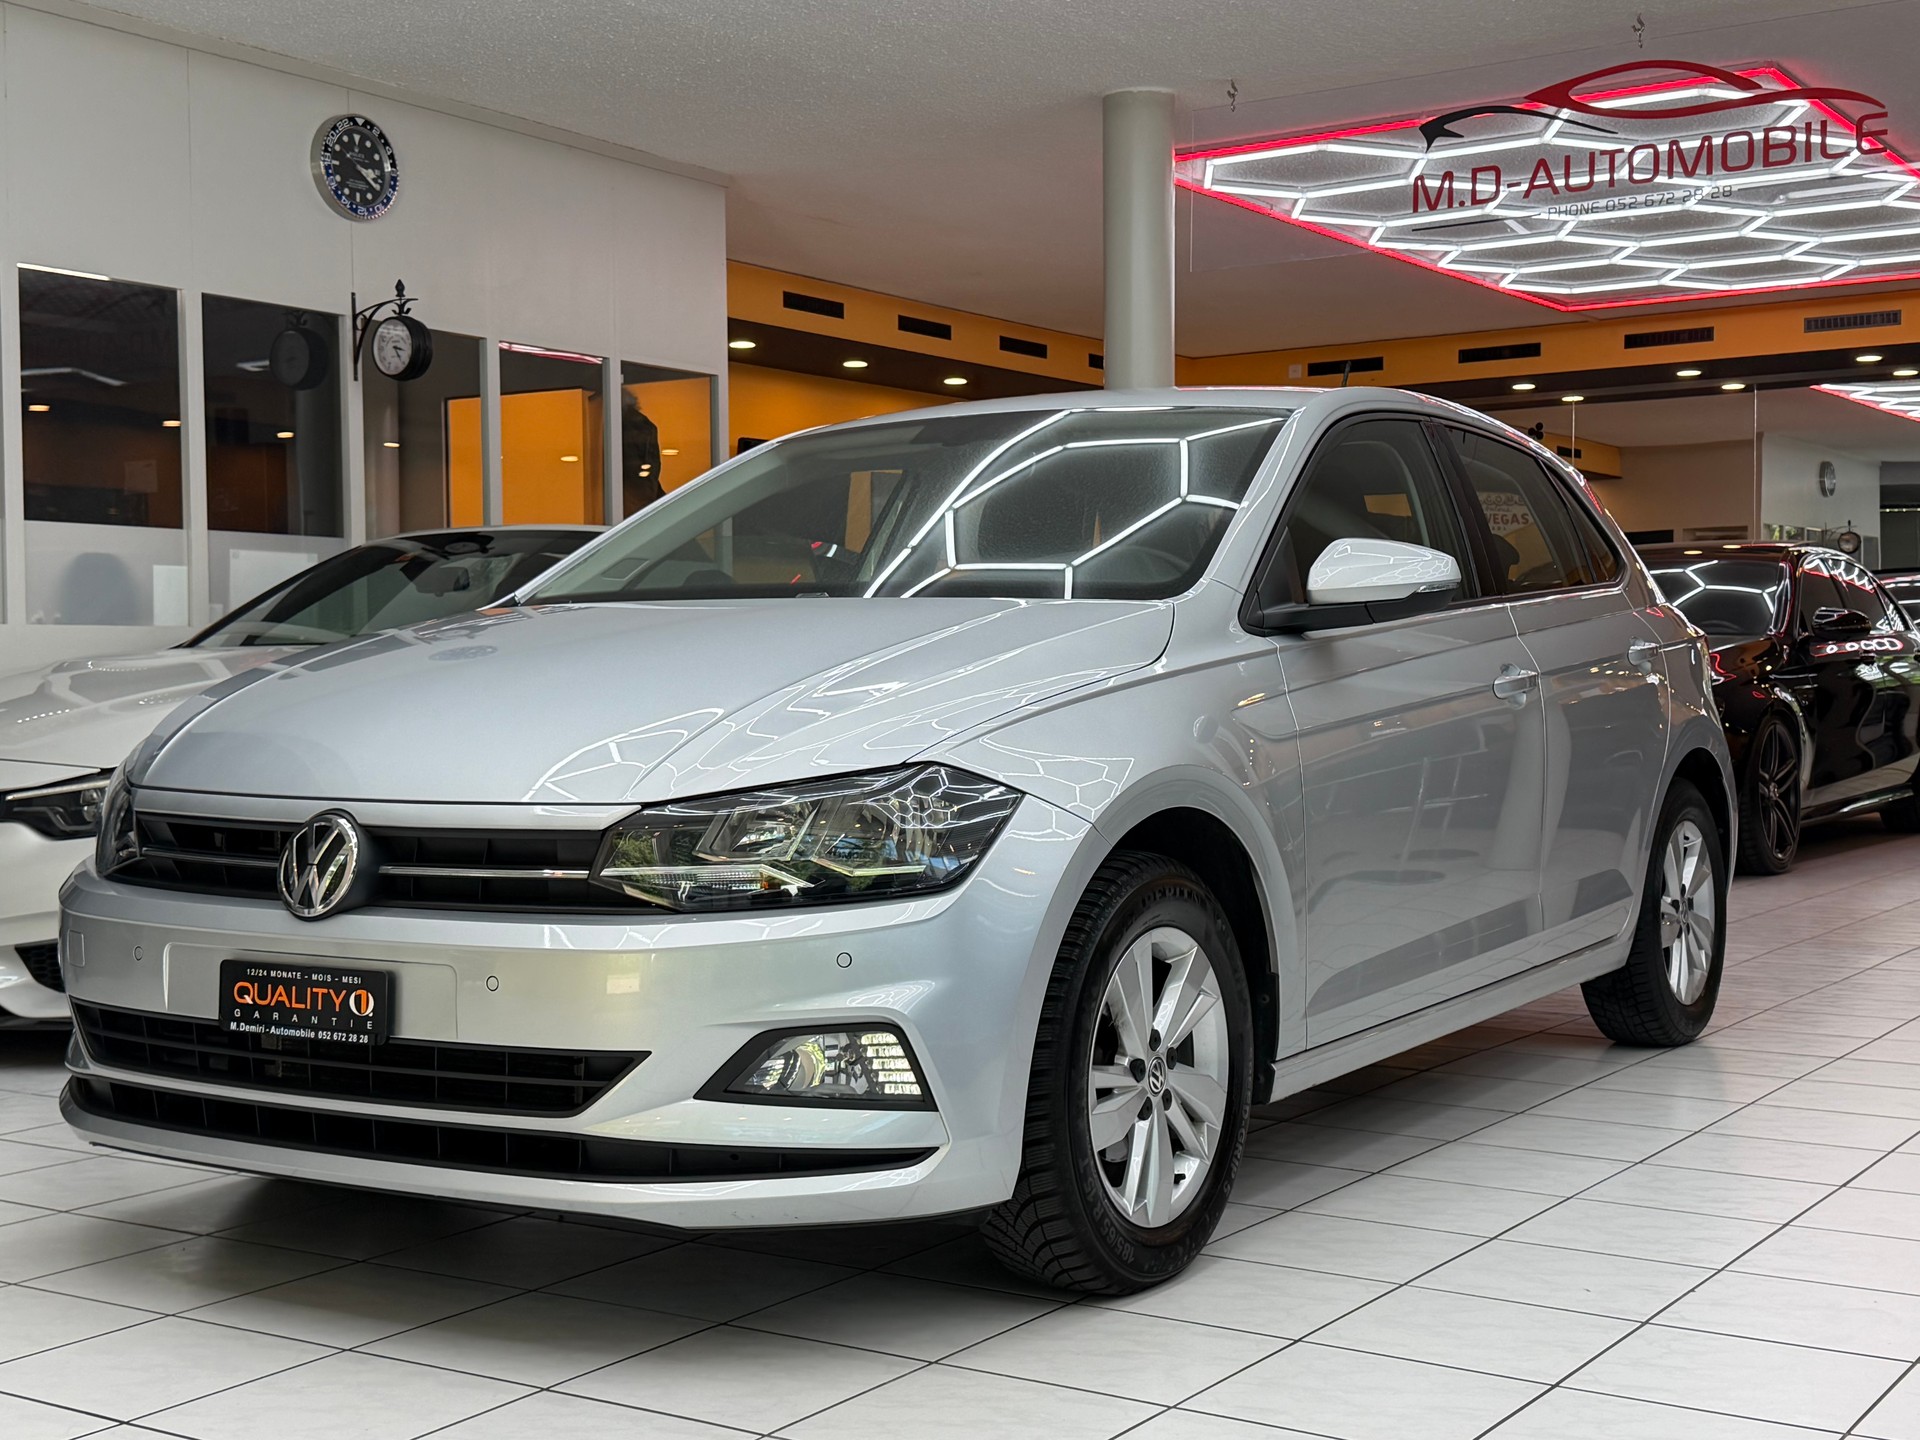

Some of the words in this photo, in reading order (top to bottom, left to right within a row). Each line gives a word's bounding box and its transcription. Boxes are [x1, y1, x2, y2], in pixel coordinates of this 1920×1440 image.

[336, 118, 350, 131] 22
[372, 126, 380, 137] 2
[326, 131, 337, 147] 20
[385, 147, 393, 156] 4
[1413, 111, 1888, 213] M.D-AUTOMOBILE
[1548, 199, 1600, 216] PHONE
[1605, 196, 1638, 213] 052
[1644, 191, 1676, 208] 672
[1682, 188, 1704, 203] 28
[1711, 184, 1733, 199] 28
[246, 968, 268, 977] 12/24
[270, 970, 302, 980] MONATE
[311, 973, 332, 982] MOIS
[341, 975, 362, 985] MESI
[233, 981, 347, 1012] QUALITY
[318, 1030, 332, 1040] 052
[333, 1032, 347, 1041] 672
[348, 1033, 358, 1043] 28
[359, 1034, 369, 1044] 28
[1100, 1218, 1135, 1266] 185/65
